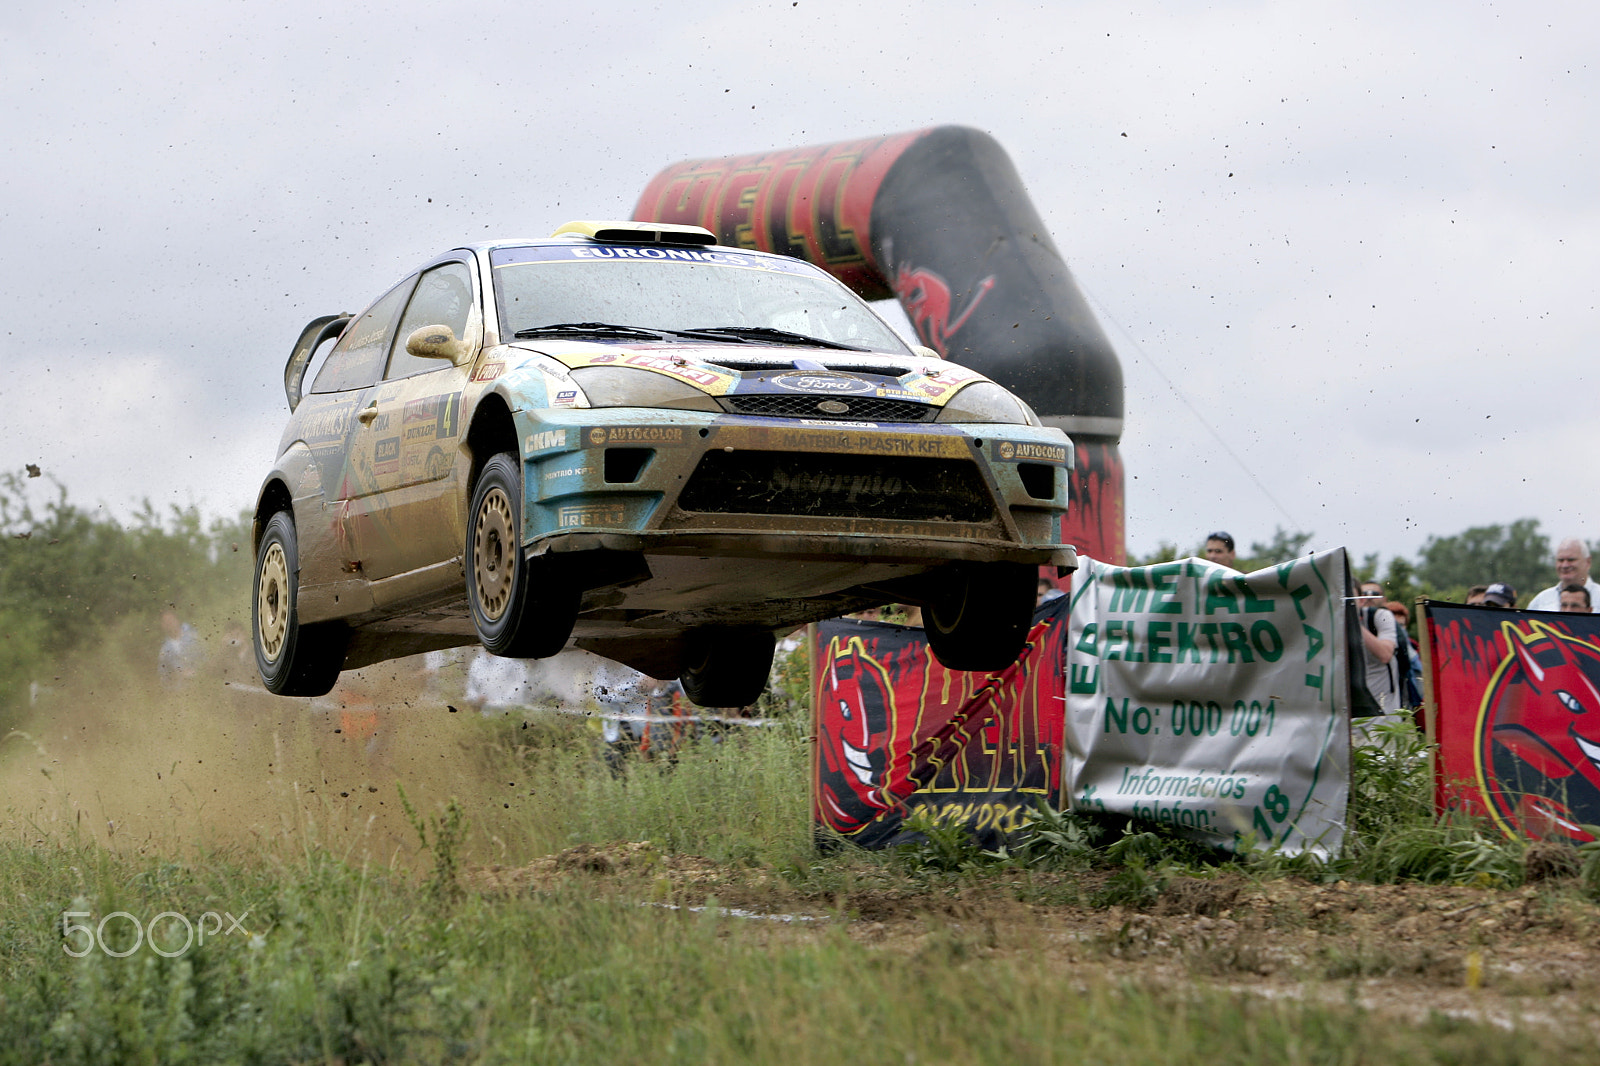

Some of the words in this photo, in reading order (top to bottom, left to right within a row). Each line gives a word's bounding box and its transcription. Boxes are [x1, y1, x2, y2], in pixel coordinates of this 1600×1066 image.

[572, 246, 749, 265] EURONICS
[798, 376, 852, 390] Ford
[443, 393, 454, 436] 4
[406, 424, 436, 439] DUNLOP
[524, 429, 566, 453] CKM
[608, 427, 683, 441] AUTOCOLOR
[1015, 443, 1066, 460] AUTOCOLOR
[1108, 563, 1275, 615] METAL
[1103, 619, 1284, 664] ELEKTRO
[1104, 697, 1160, 735] No:
[1171, 700, 1222, 736] 000
[1230, 700, 1275, 737] 001
[1117, 766, 1248, 799] Információs
